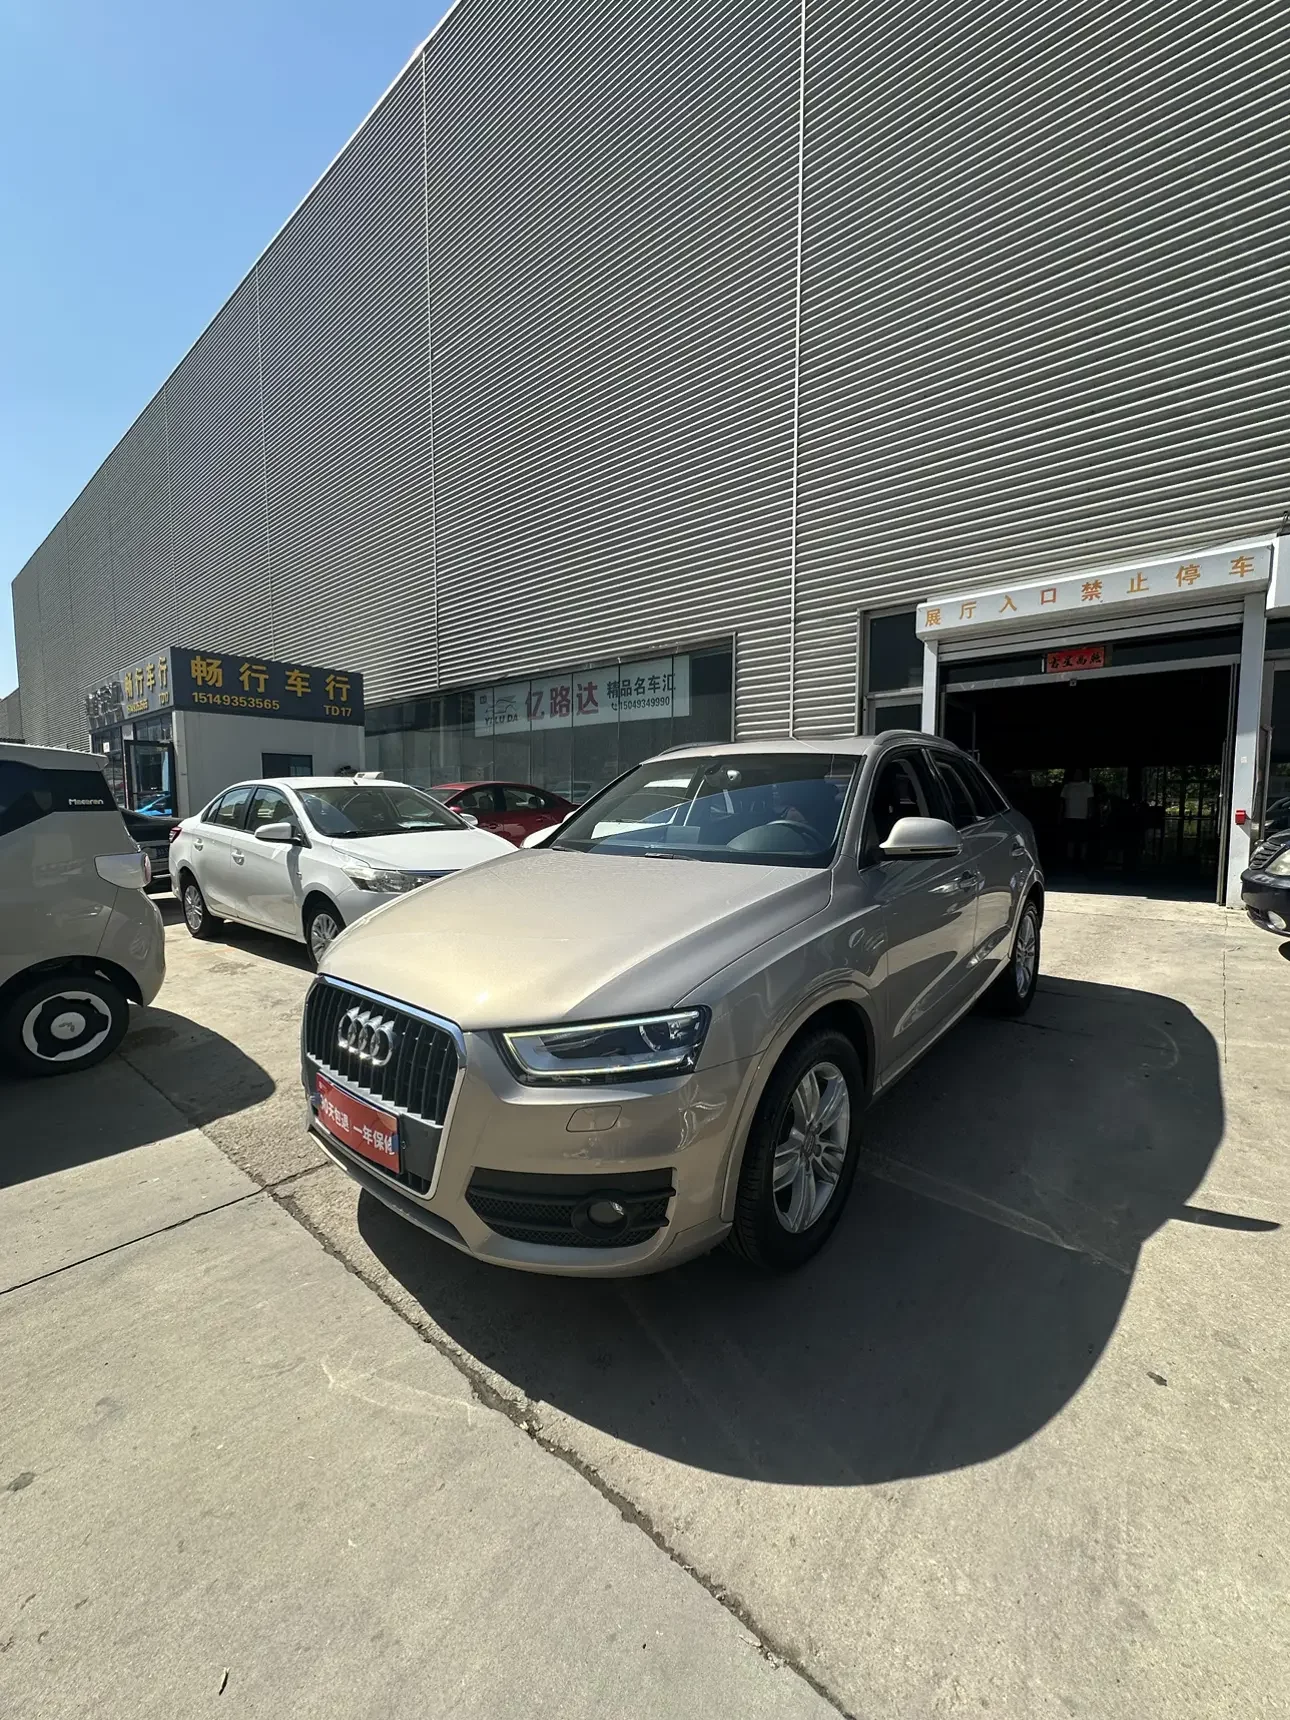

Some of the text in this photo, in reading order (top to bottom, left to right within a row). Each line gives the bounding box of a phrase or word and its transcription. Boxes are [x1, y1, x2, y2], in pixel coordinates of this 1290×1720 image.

[924, 555, 1256, 628] 展厅入口禁止停车
[190, 655, 351, 702] 畅行车行
[606, 673, 676, 699] 精品名车汇
[192, 692, 280, 711] 15149353565
[323, 704, 352, 717] TD17
[525, 681, 599, 722] 亿路达
[620, 696, 670, 710] 15049349990
